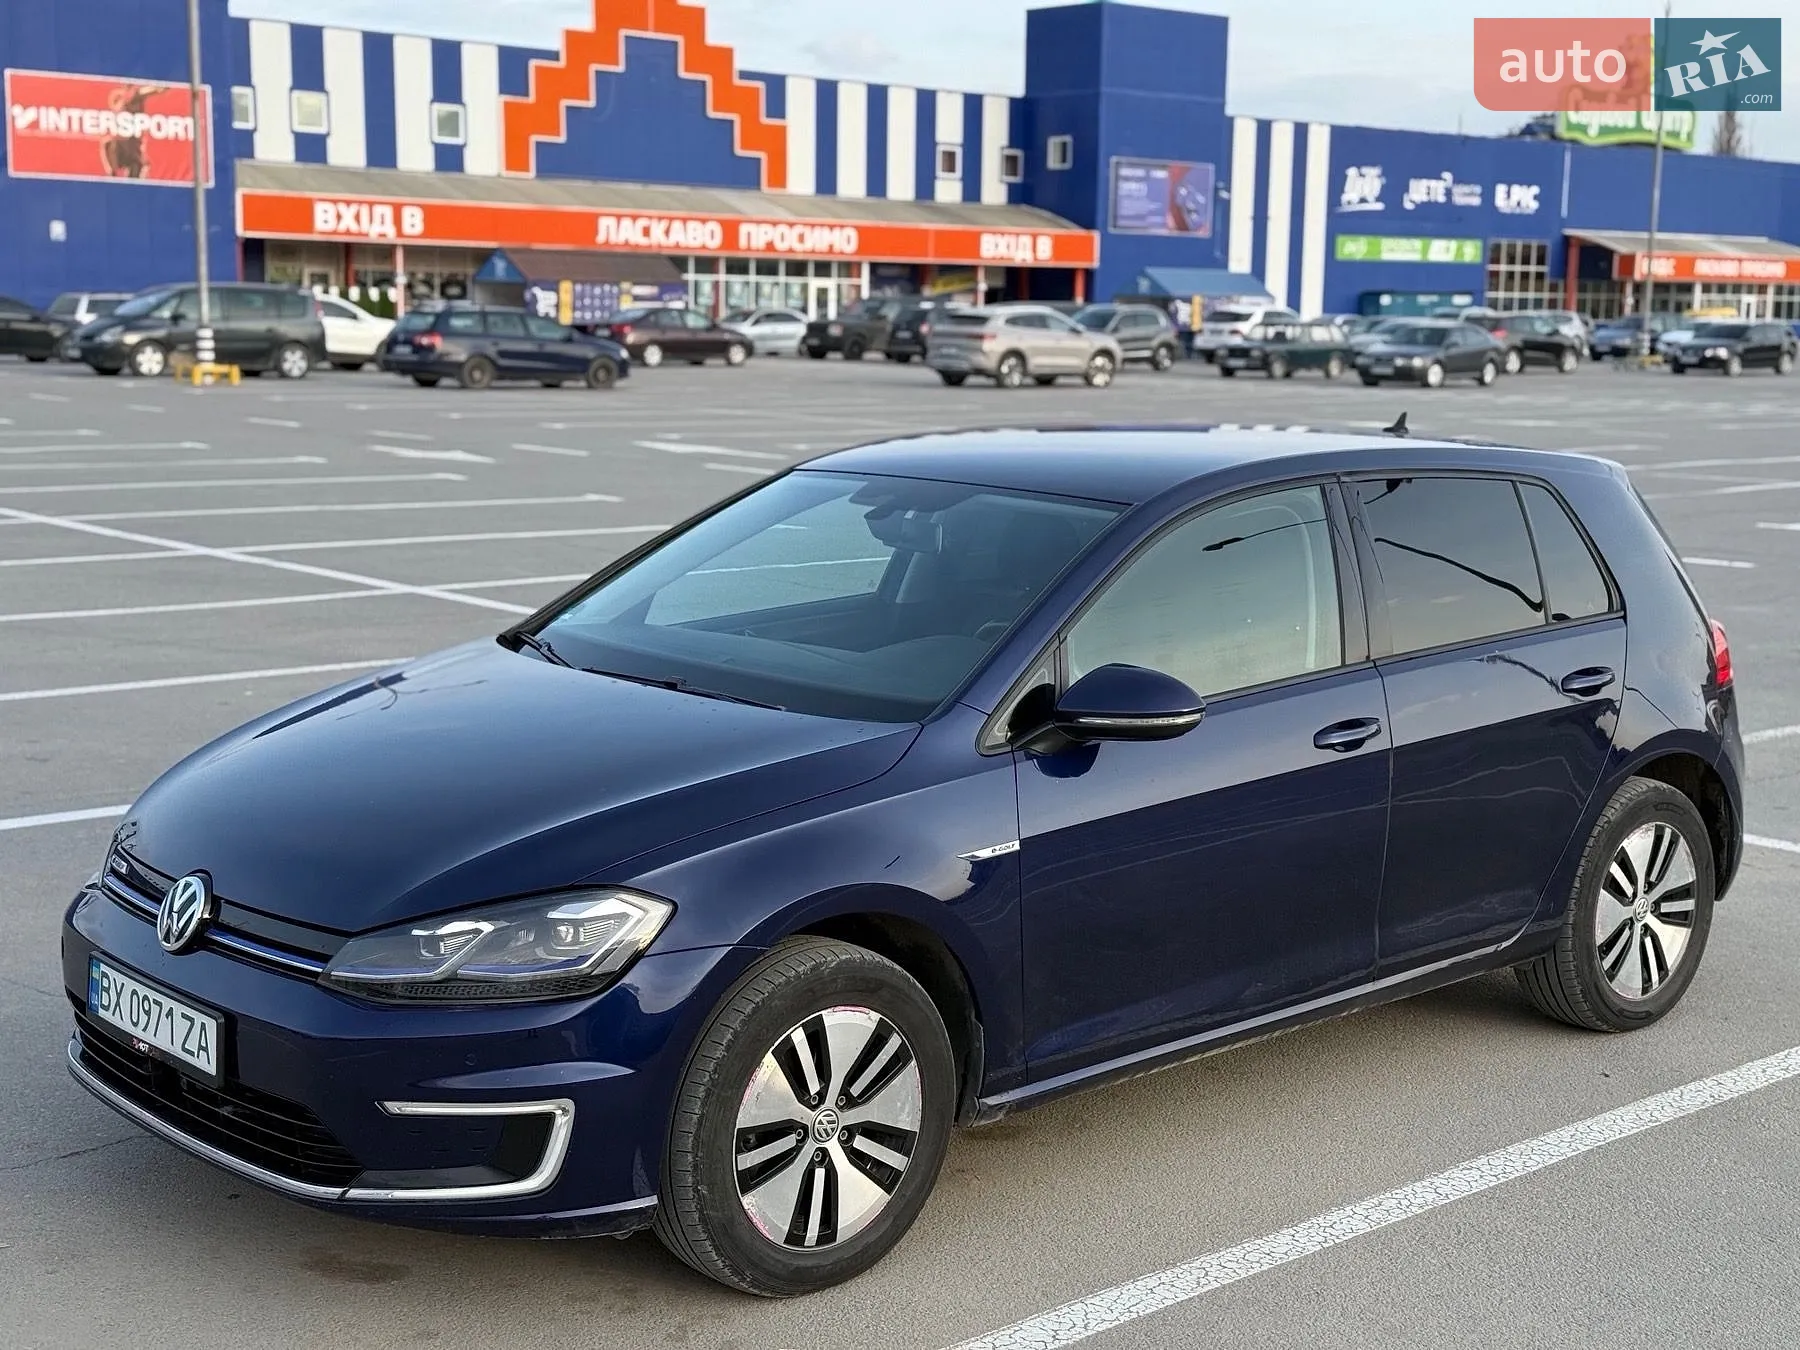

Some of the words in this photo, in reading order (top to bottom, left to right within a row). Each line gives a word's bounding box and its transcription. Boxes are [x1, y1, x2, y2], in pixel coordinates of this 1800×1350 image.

[38, 105, 195, 142] INTERSPORT
[313, 201, 397, 240] ВХІД
[401, 205, 425, 236] В
[595, 215, 723, 249] ЛАСКАВО
[738, 222, 858, 254] ПРОСИМО
[979, 232, 1032, 262] ВХІД
[100, 970, 125, 1021] BX
[130, 988, 175, 1047] 0971
[181, 1012, 212, 1066] ZA
